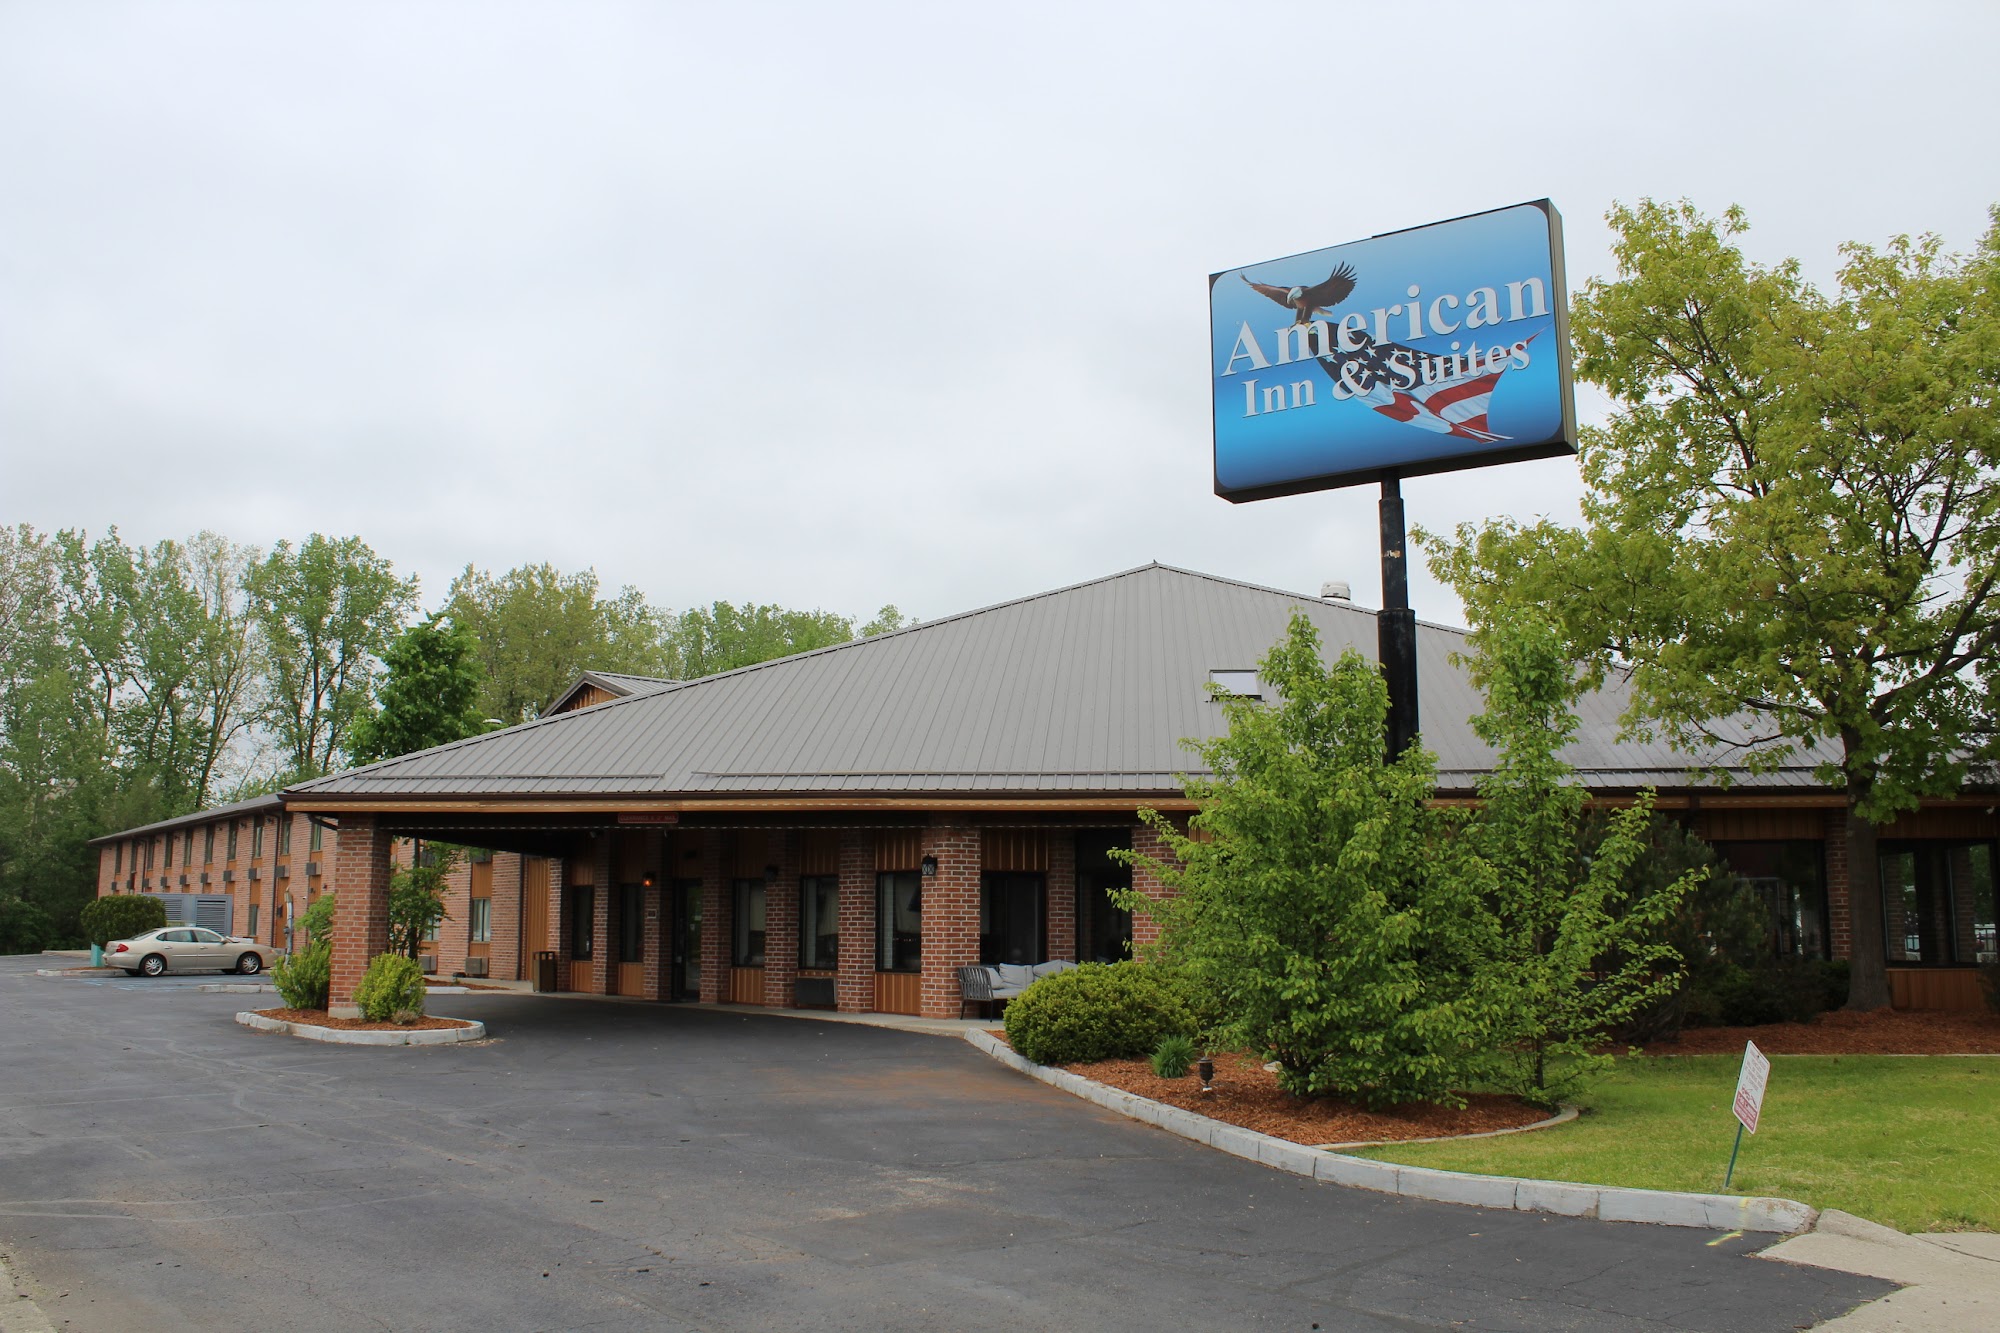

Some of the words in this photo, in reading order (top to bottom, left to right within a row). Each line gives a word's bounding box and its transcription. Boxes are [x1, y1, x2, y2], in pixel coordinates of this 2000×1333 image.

[1221, 276, 1550, 377] American
[1241, 379, 1317, 418] Inn
[1332, 360, 1372, 401] &
[1389, 340, 1531, 391] Suites
